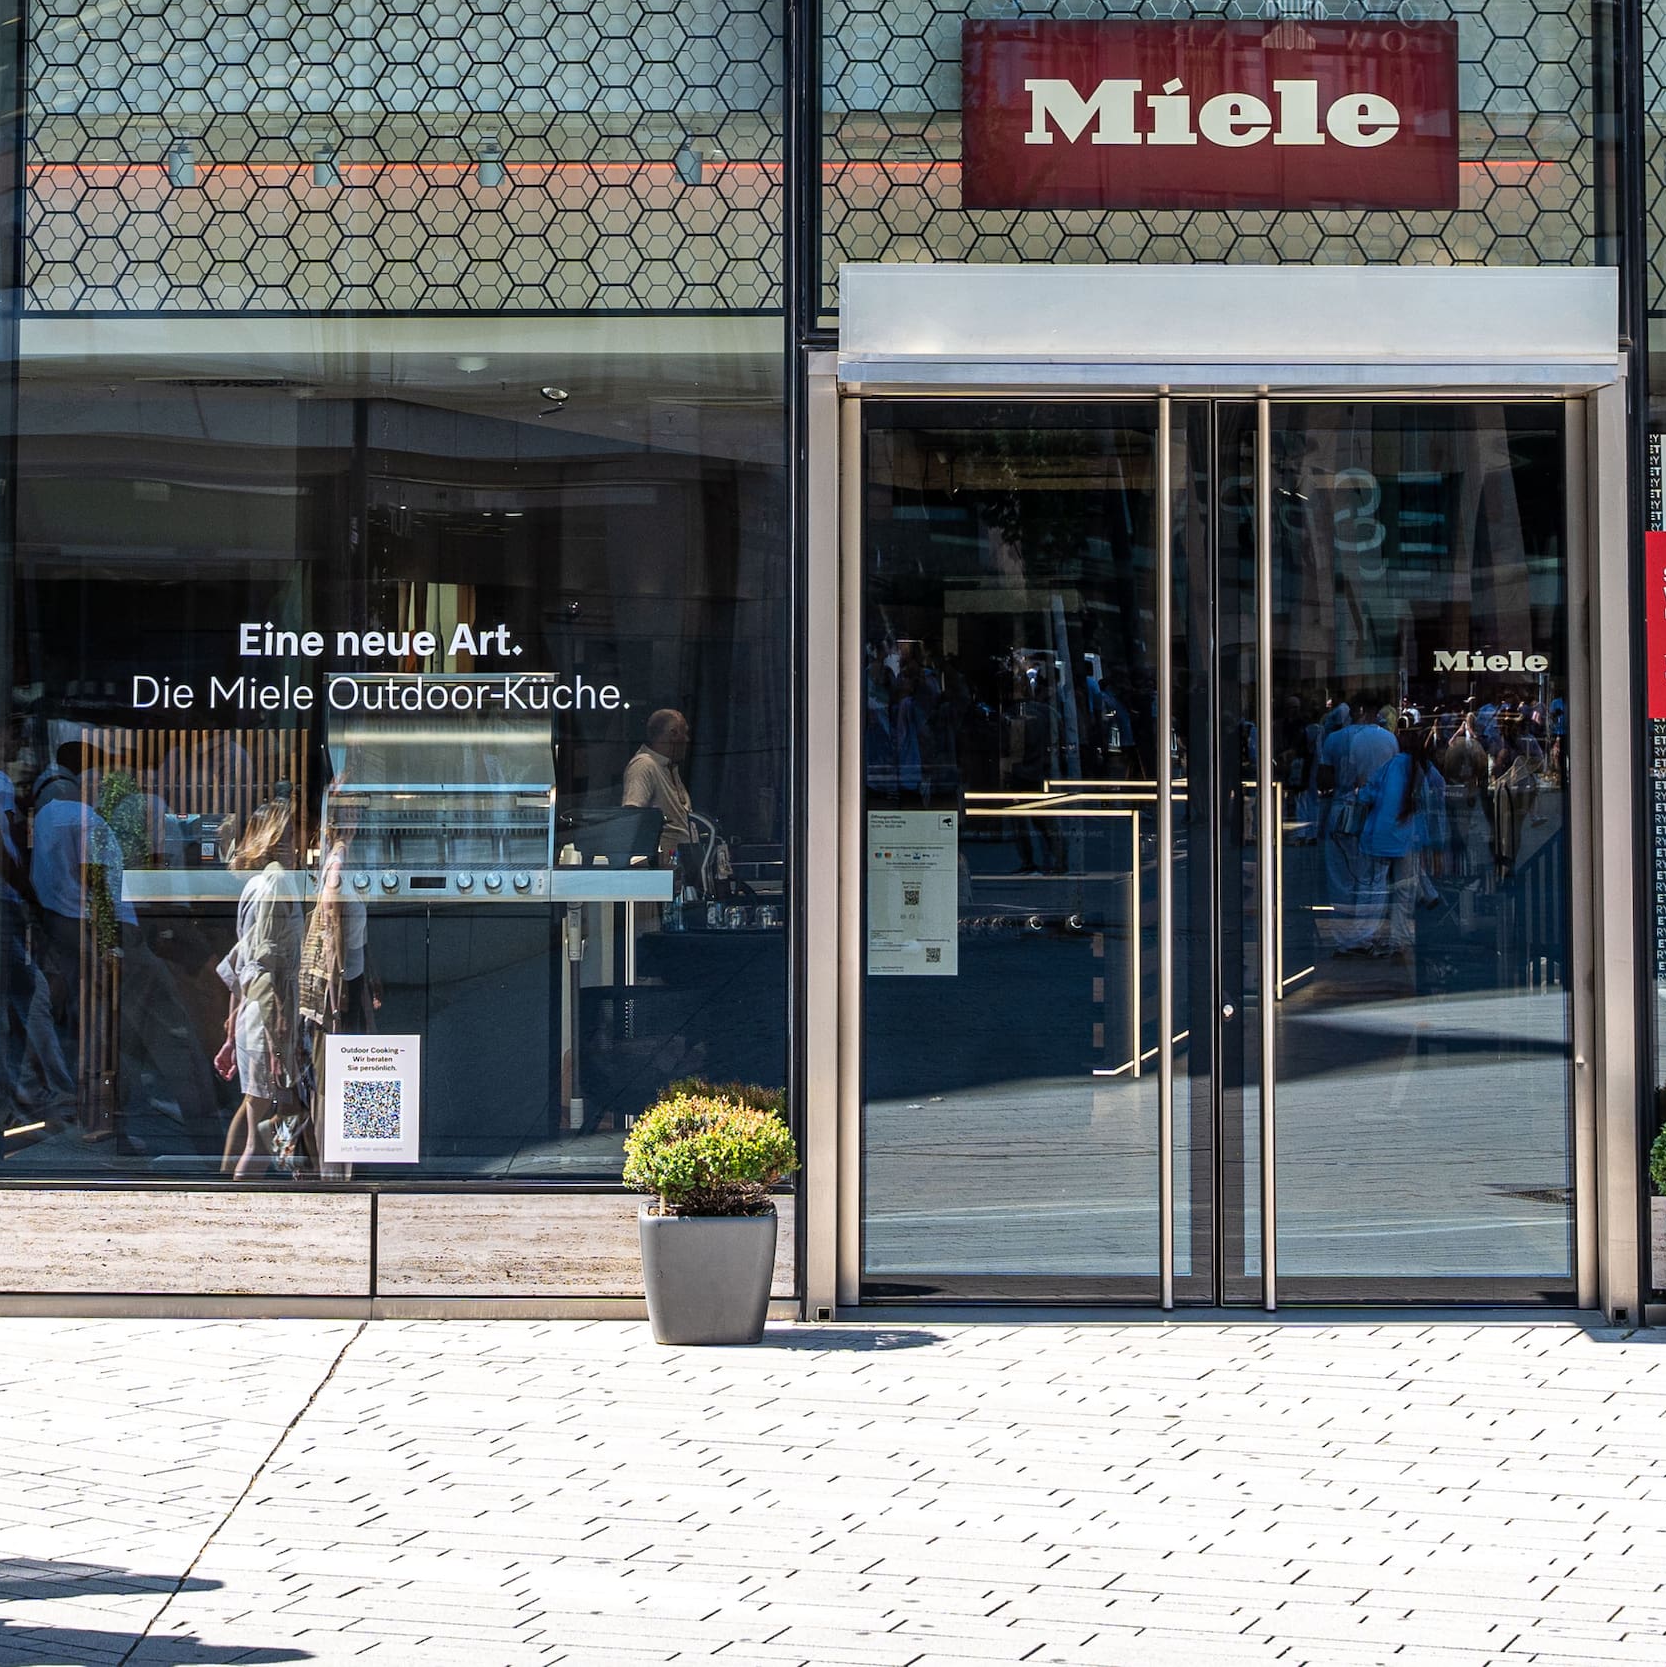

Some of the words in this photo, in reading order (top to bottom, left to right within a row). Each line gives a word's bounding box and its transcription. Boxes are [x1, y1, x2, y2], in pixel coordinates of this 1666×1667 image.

[1024, 77, 1400, 148] Miele
[239, 621, 324, 657] Eine
[337, 630, 436, 657] neue
[447, 623, 523, 656] Art.
[1433, 650, 1548, 672] Miele
[132, 675, 194, 709] Die
[210, 675, 314, 710] Miele
[328, 672, 630, 711] Outdoor-Küche.
[340, 1046, 369, 1054] Outdoor
[370, 1046, 399, 1055] Cooking
[360, 1064, 397, 1072] persönlich.
